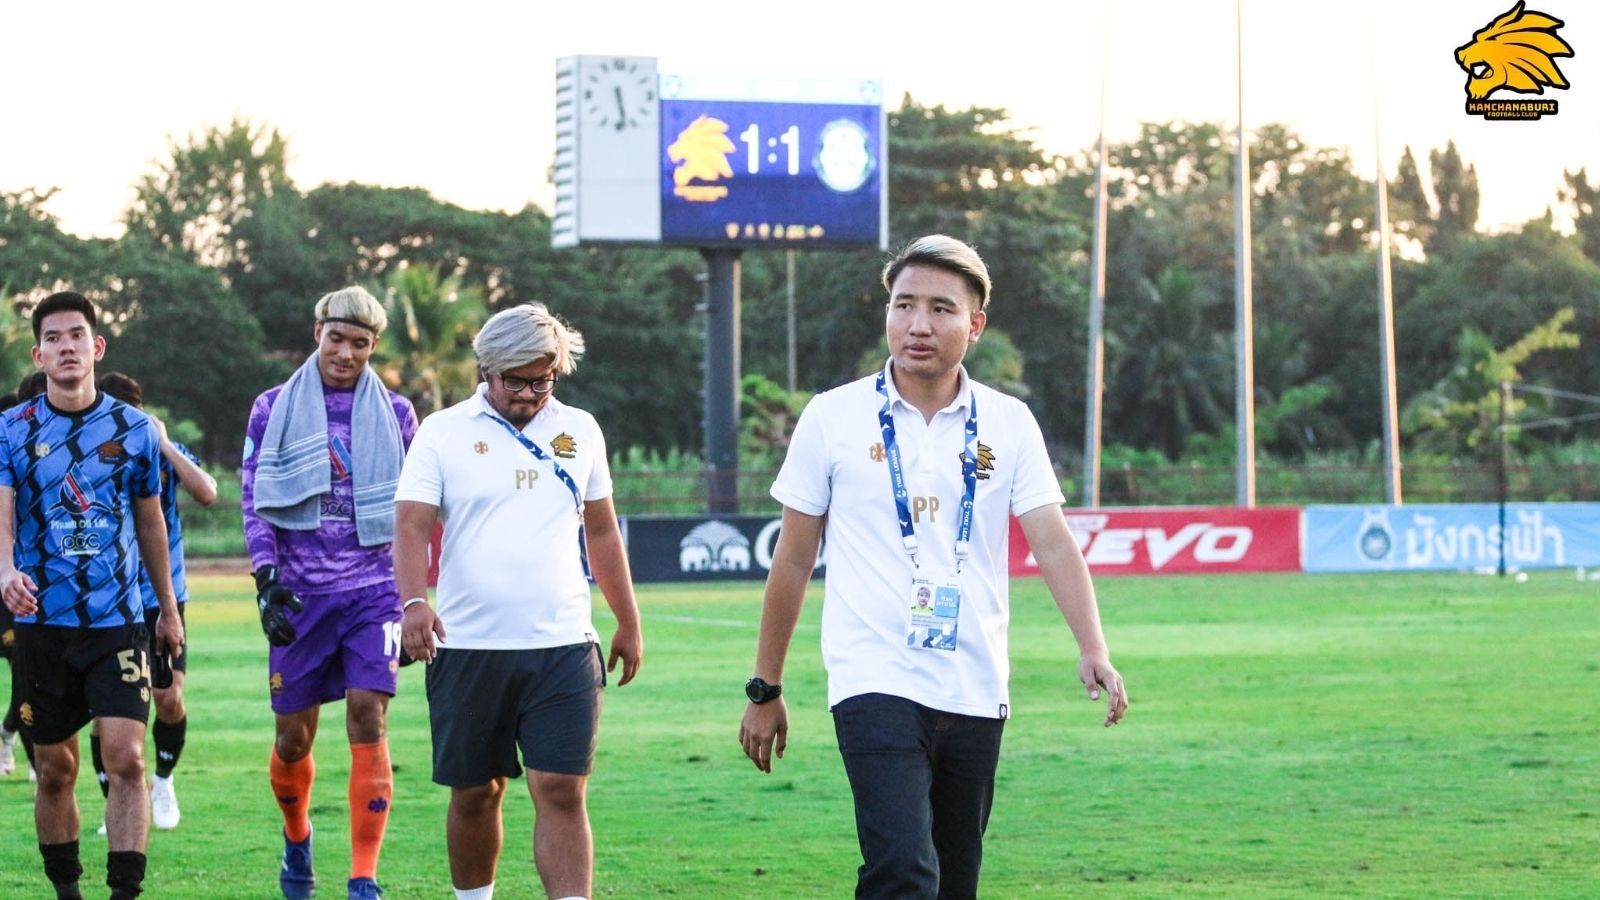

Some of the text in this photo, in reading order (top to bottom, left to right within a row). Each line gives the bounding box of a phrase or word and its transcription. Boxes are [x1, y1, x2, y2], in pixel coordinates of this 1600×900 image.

[739, 123, 799, 175] 1:1
[515, 469, 538, 489] PP
[913, 496, 939, 523] PP
[382, 621, 402, 658] 19
[117, 648, 152, 687] 54
